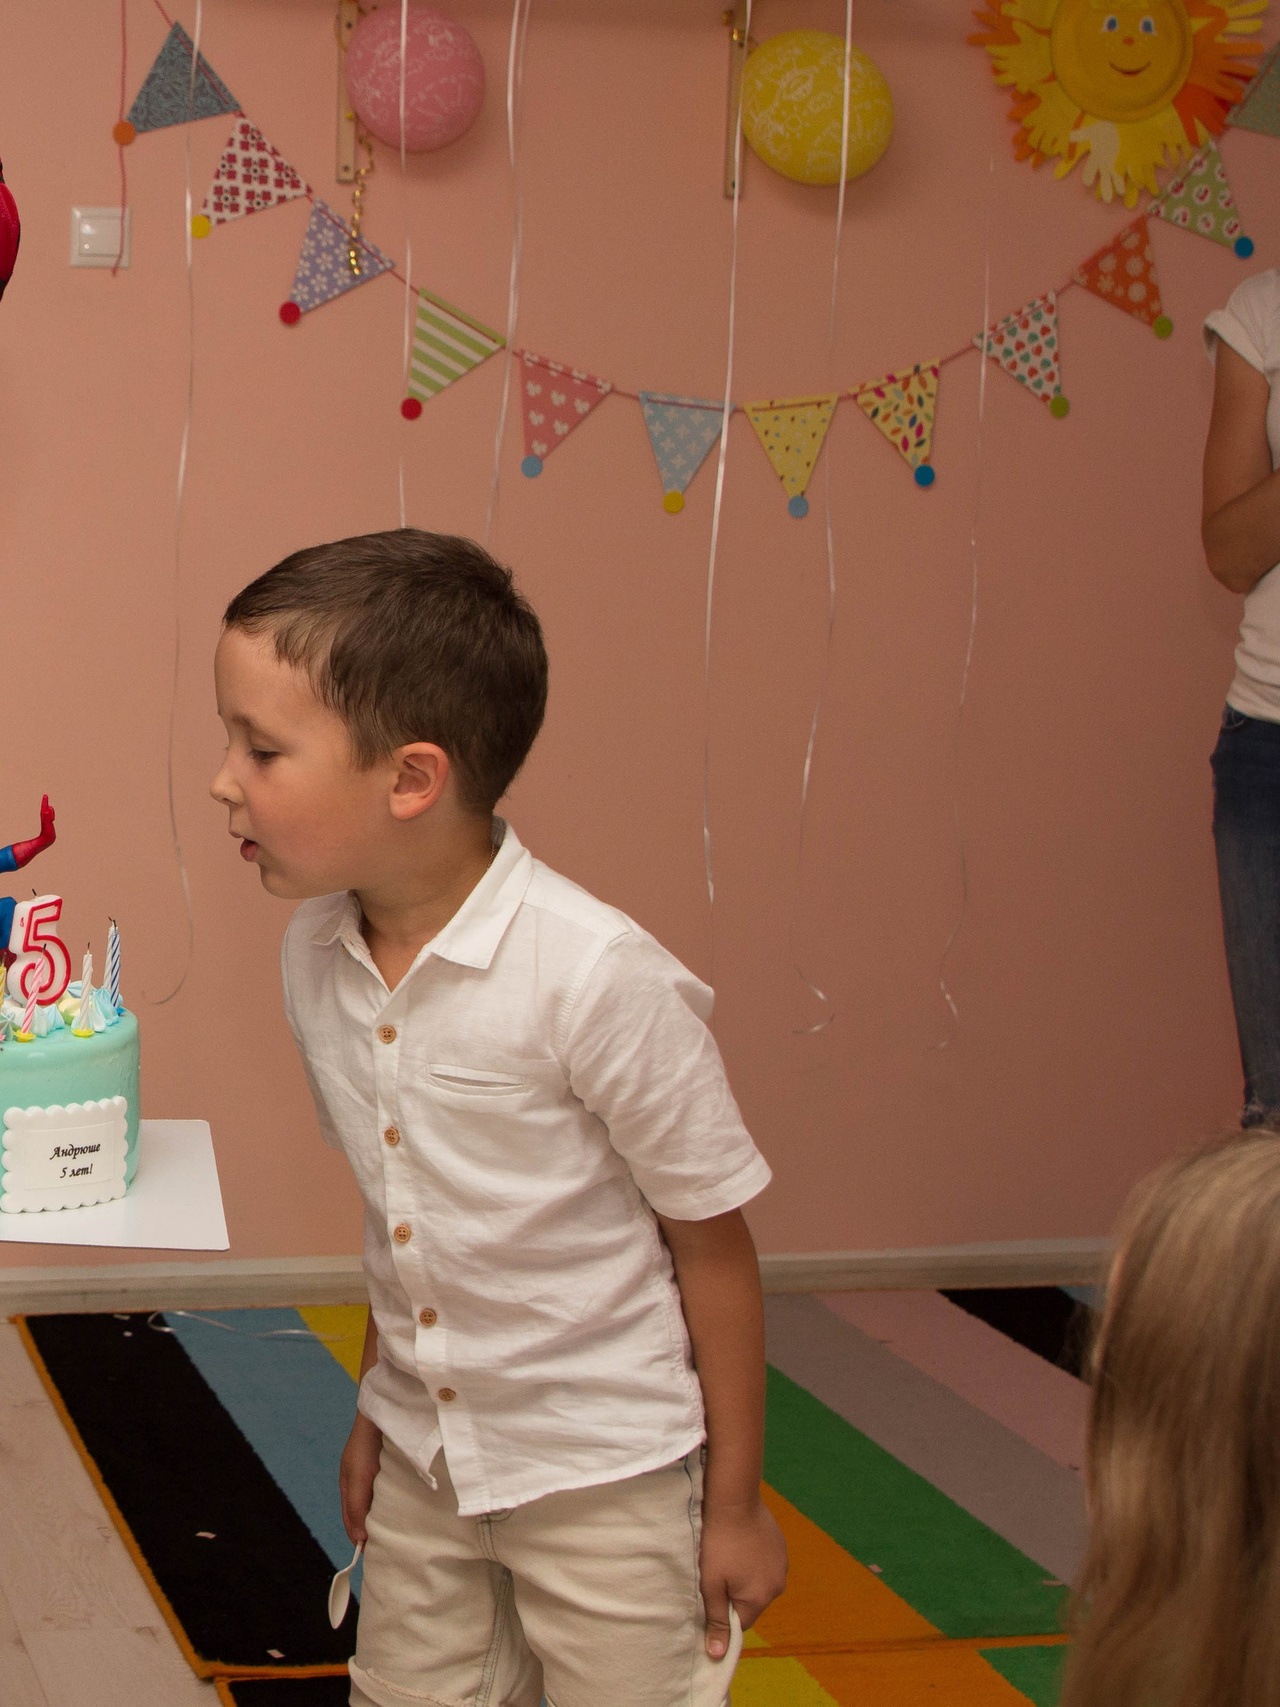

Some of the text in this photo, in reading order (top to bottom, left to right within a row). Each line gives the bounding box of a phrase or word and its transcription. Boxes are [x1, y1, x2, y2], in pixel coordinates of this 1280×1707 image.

[20, 897, 71, 1005] 5
[49, 1143, 101, 1160] Андрюше
[59, 1163, 93, 1179] 5 лет!
